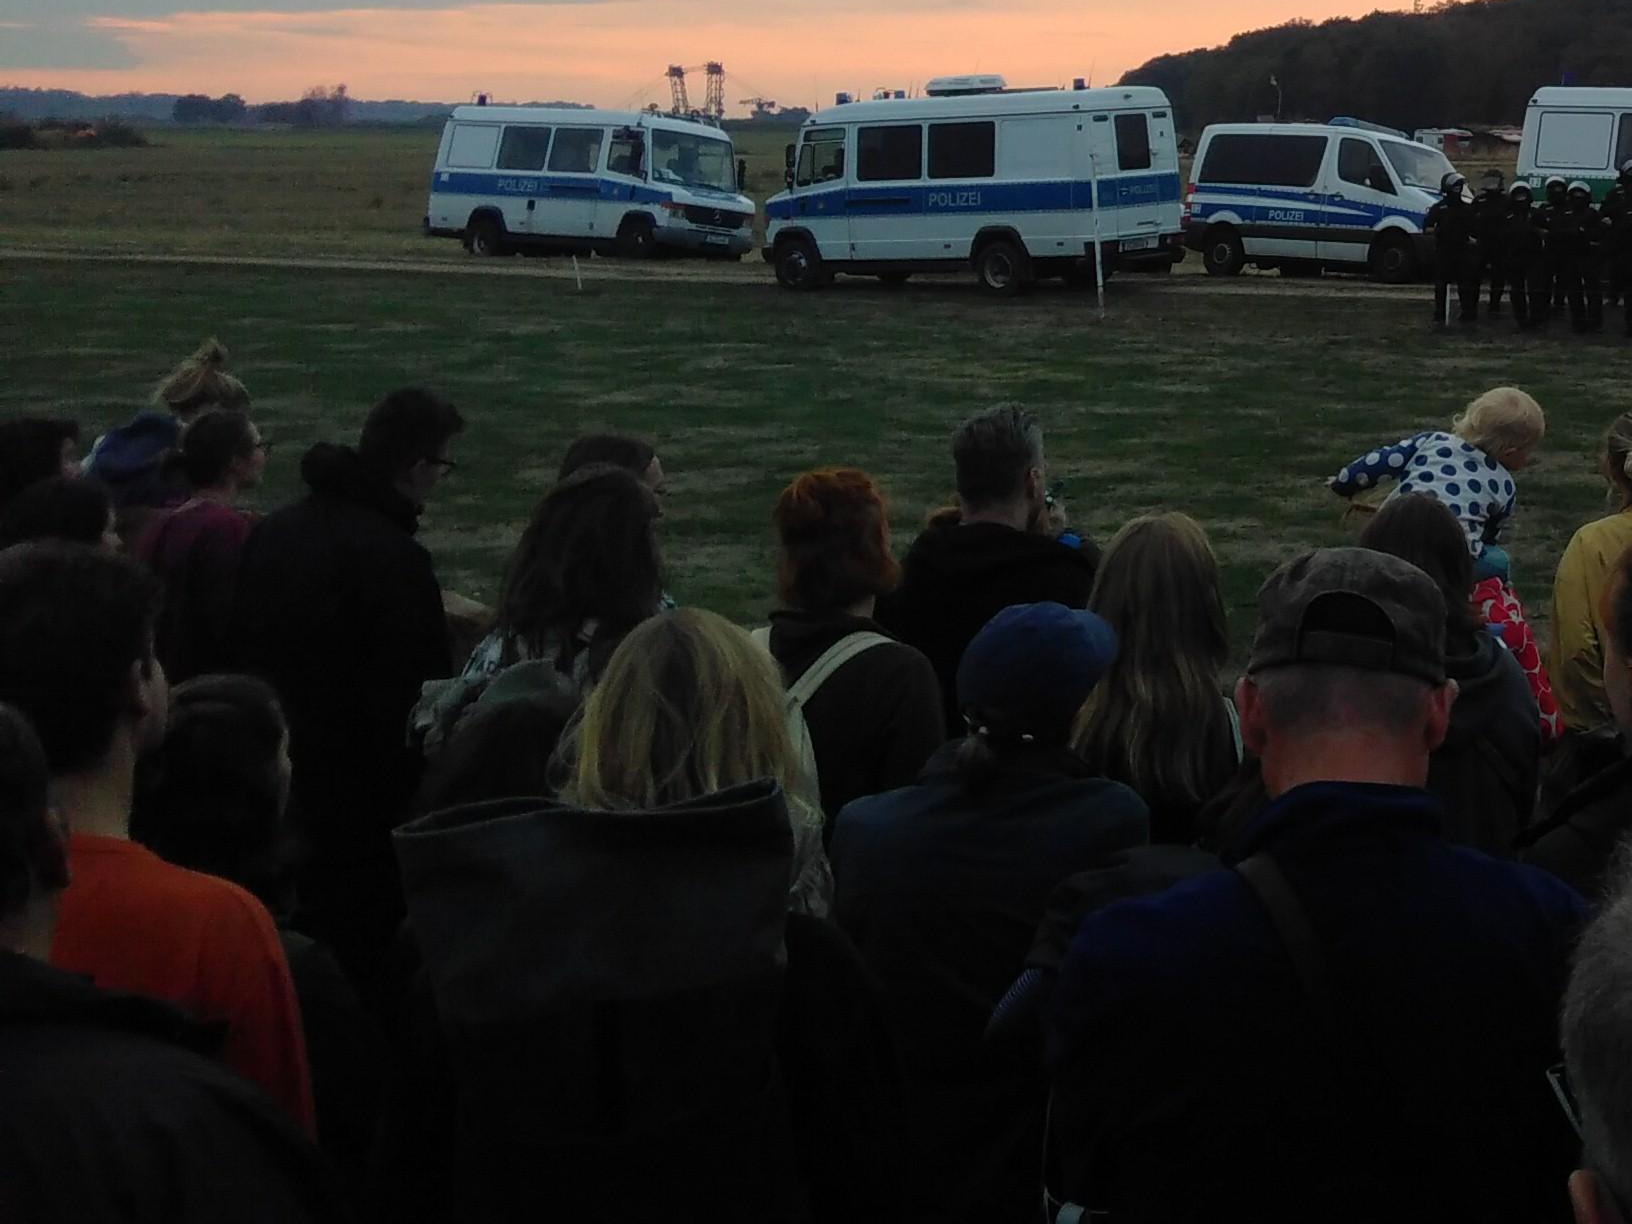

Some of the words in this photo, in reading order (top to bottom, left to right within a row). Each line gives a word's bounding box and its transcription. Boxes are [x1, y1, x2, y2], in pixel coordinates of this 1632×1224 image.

[498, 179, 539, 192] POLIZEI
[929, 191, 981, 207] POLIZEI
[1268, 209, 1304, 221] POLIZEI
